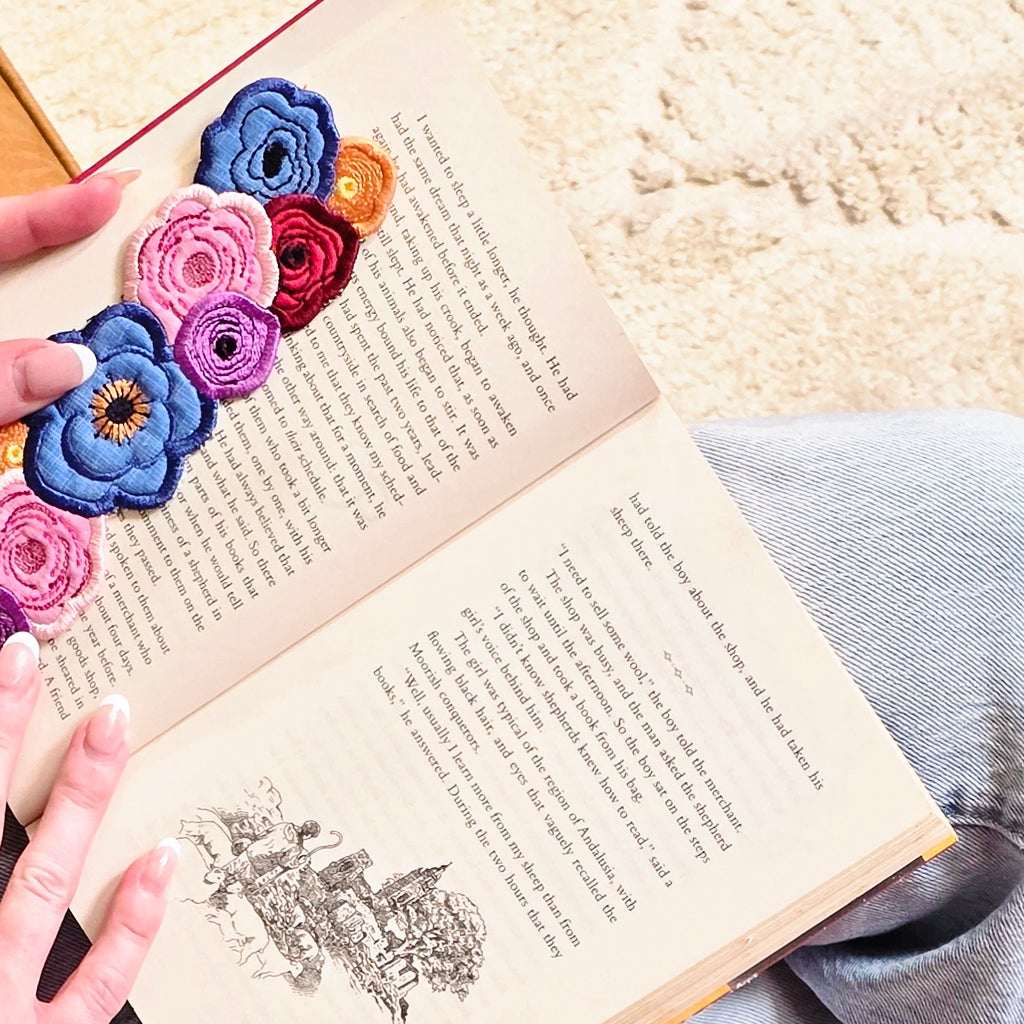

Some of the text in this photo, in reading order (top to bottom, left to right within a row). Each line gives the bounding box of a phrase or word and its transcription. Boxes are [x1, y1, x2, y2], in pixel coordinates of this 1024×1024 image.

[359, 244, 480, 461] of his animals also began to stir. It was
[389, 111, 556, 414] had the same dream that night as a week ago, and once
[394, 170, 489, 337] had awakened before it ended.
[400, 227, 518, 438] taking up his crook, began to awaken
[415, 113, 579, 402] I wanted to sleep a little longer, he thought. He had
[247, 404, 332, 553] them who took a bit longer
[321, 314, 428, 497] countryside in search of food and
[337, 297, 443, 484] had spent the past two years, lead-
[175, 490, 245, 611] or when he would tell
[213, 428, 296, 577] He had always believed that
[609, 506, 653, 572] sheep there.
[107, 581, 152, 666] a merchant who
[407, 641, 481, 755] Moorish conquerors.
[459, 606, 545, 733] girl’s voice behind him.
[499, 582, 643, 804] of the shop and took a book from his bag.
[517, 568, 711, 864] to wait until the afternoon. So the boy sat on the steps
[545, 567, 733, 852] The shop was busy, and the man asked the shepherd
[627, 490, 824, 791] had told the boy about the shop, and he had taken his
[426, 629, 618, 924] flowing black hair, and eyes that vaguely recalled the
[453, 629, 638, 912] The girl was typical of the region of Andalusia, with
